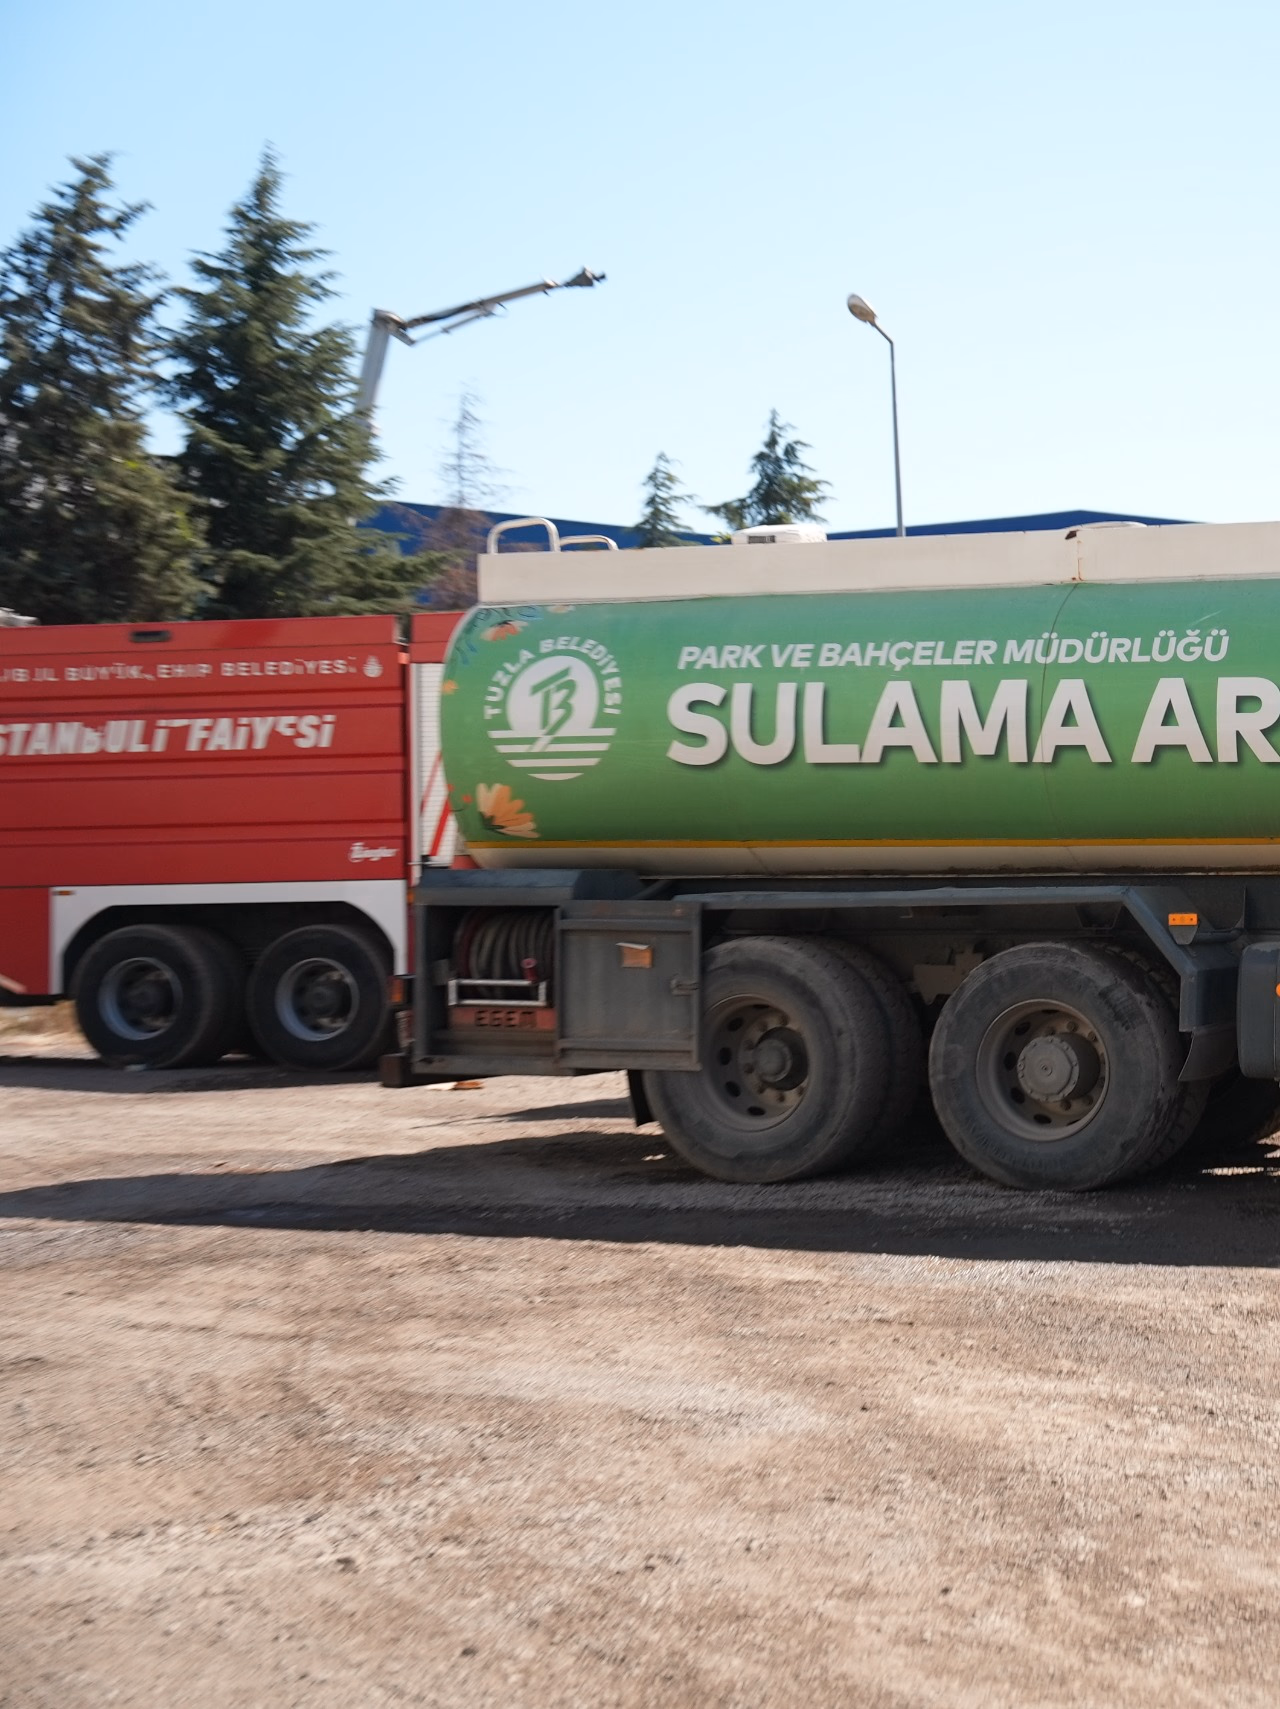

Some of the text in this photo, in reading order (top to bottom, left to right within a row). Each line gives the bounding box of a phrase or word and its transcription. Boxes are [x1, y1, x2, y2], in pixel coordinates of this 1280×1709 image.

[484, 649, 536, 720] TUZLA
[677, 628, 1230, 672] PARK VE BAHÇELER MÜDÜRLÜĞÜ
[666, 678, 1112, 766] SULAMA
